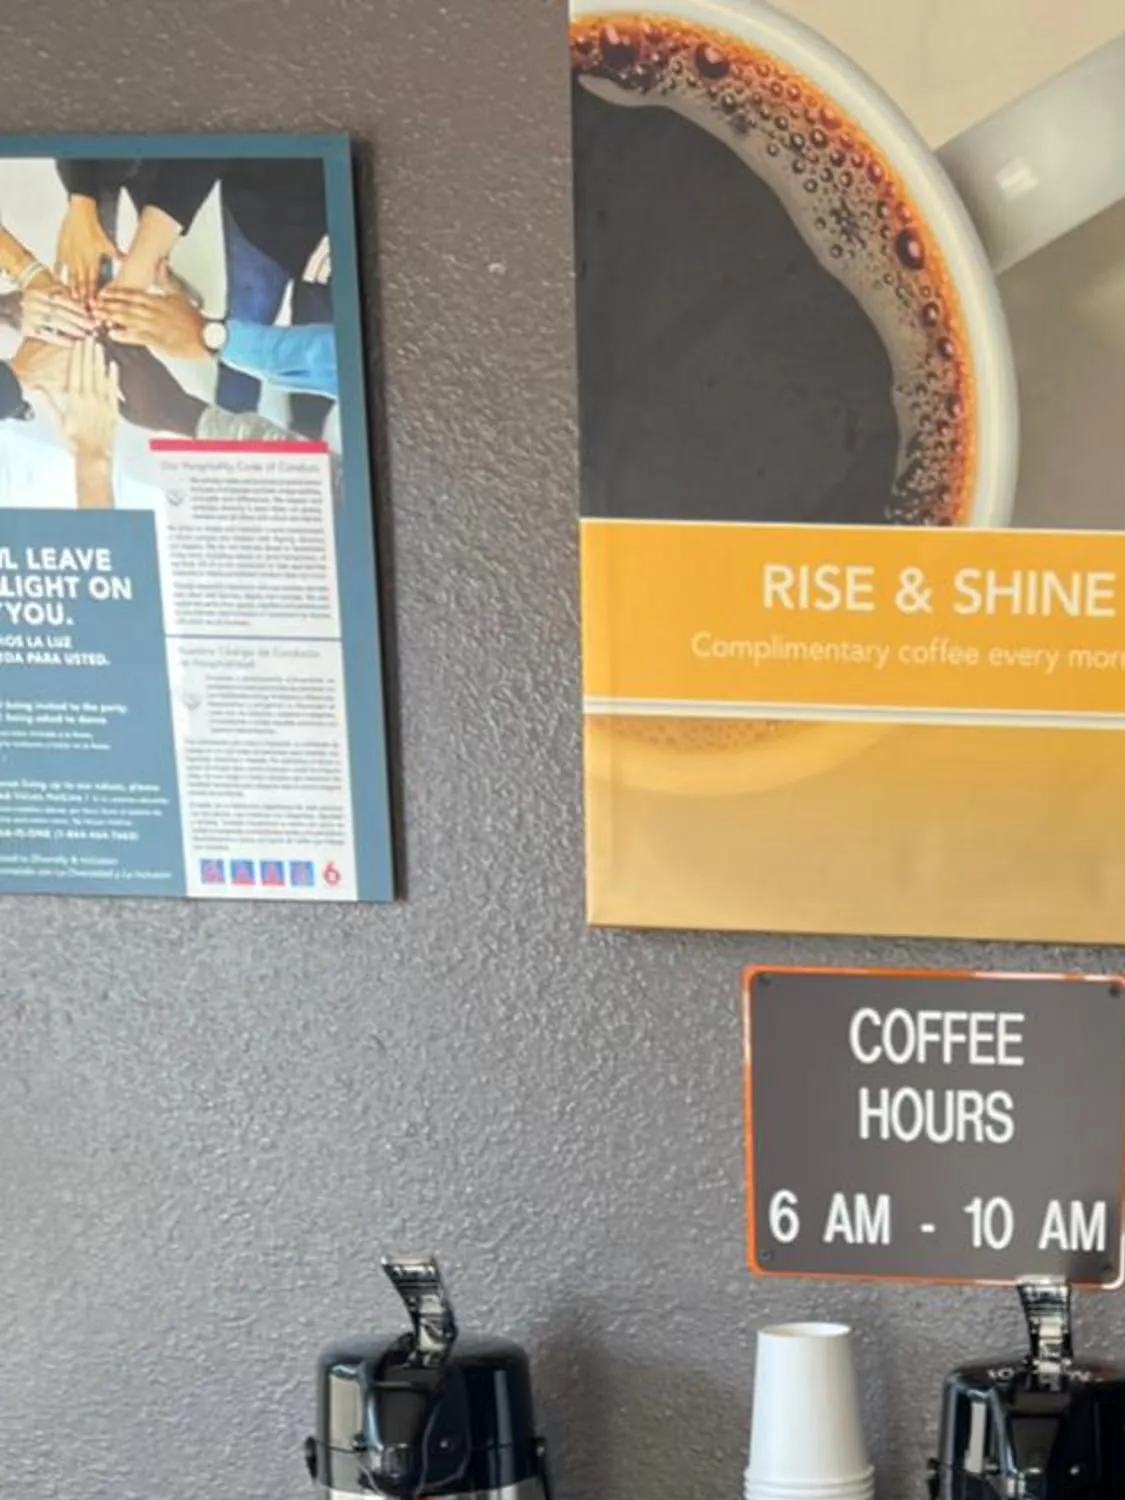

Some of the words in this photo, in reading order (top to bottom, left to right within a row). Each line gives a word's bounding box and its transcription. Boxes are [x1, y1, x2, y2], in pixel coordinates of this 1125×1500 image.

[26, 547, 112, 571] LEAVE
[0, 575, 80, 599] LIGHT
[88, 576, 132, 600] ON
[762, 562, 876, 612] RISE
[895, 565, 934, 614] &
[953, 567, 1117, 618] SHINE
[5, 601, 75, 626] YOU.
[689, 631, 890, 670] Complimentary
[898, 635, 980, 667] coffee
[988, 645, 1060, 674] every
[323, 861, 342, 886] 6
[849, 1007, 1025, 1066] COFFEE
[858, 1086, 1015, 1143] HOURS
[768, 1188, 800, 1243] 6
[823, 1192, 891, 1246] AM
[963, 1196, 1014, 1250] 10
[1038, 1199, 1107, 1252] AM
